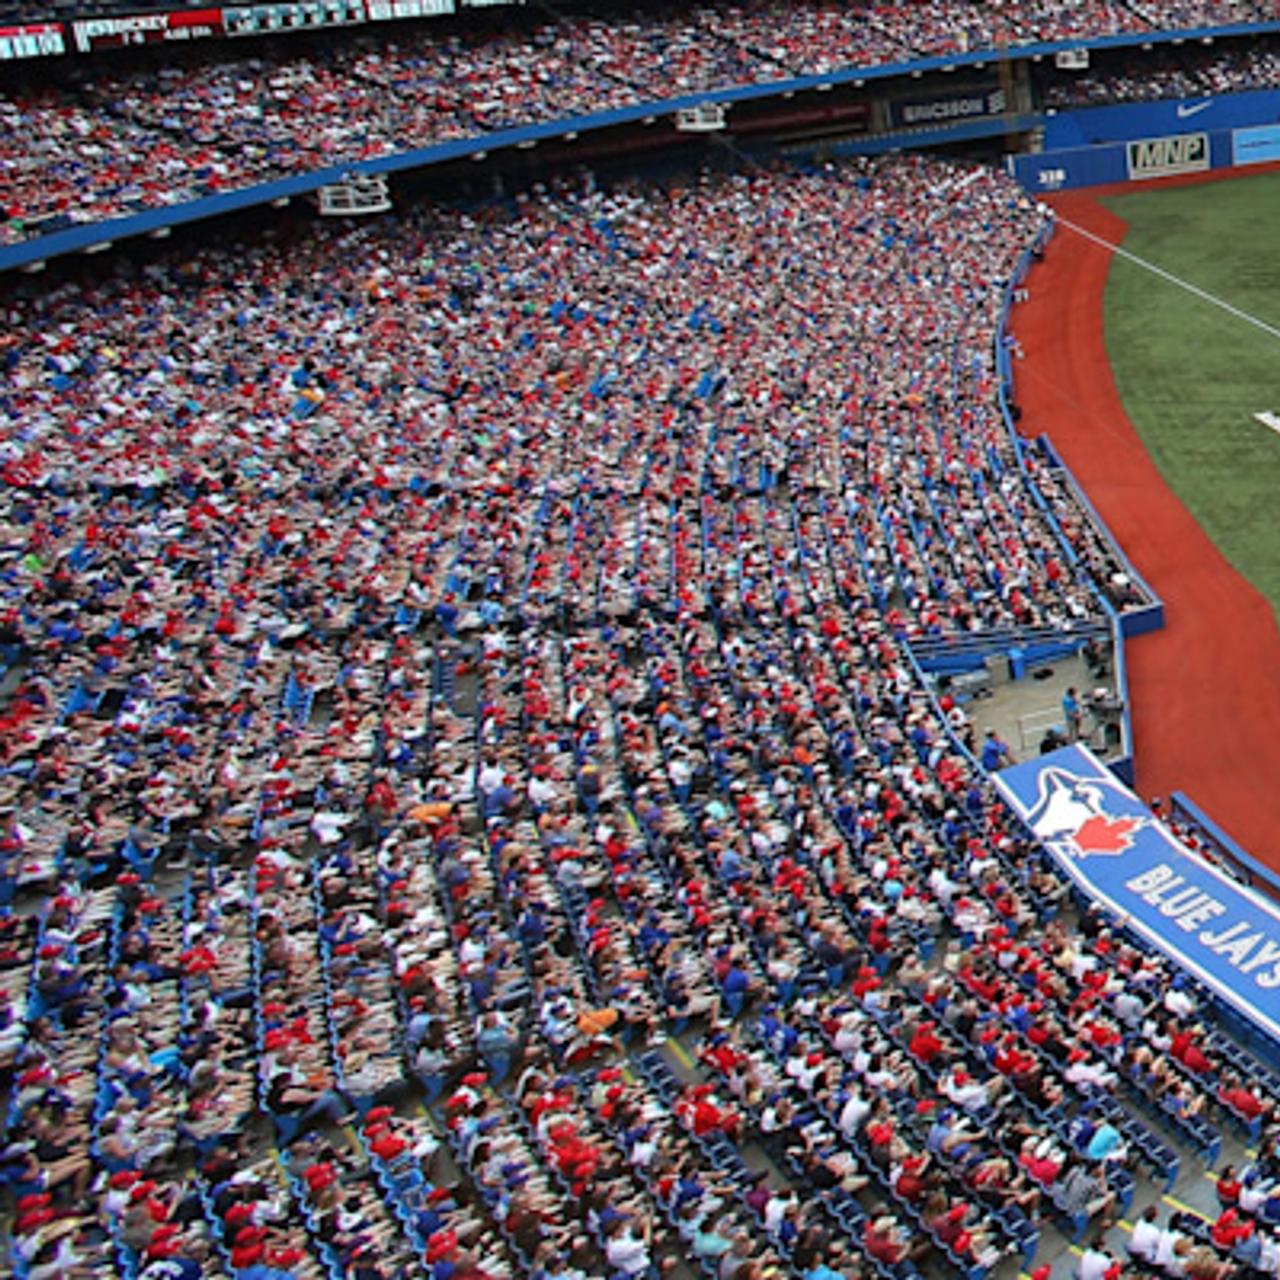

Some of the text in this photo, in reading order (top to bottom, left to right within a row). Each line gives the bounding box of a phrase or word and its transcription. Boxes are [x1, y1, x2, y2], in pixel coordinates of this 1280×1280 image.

[904, 98, 983, 122] ERICSSON
[1135, 137, 1201, 170] MNP
[1124, 863, 1228, 933] BLUE
